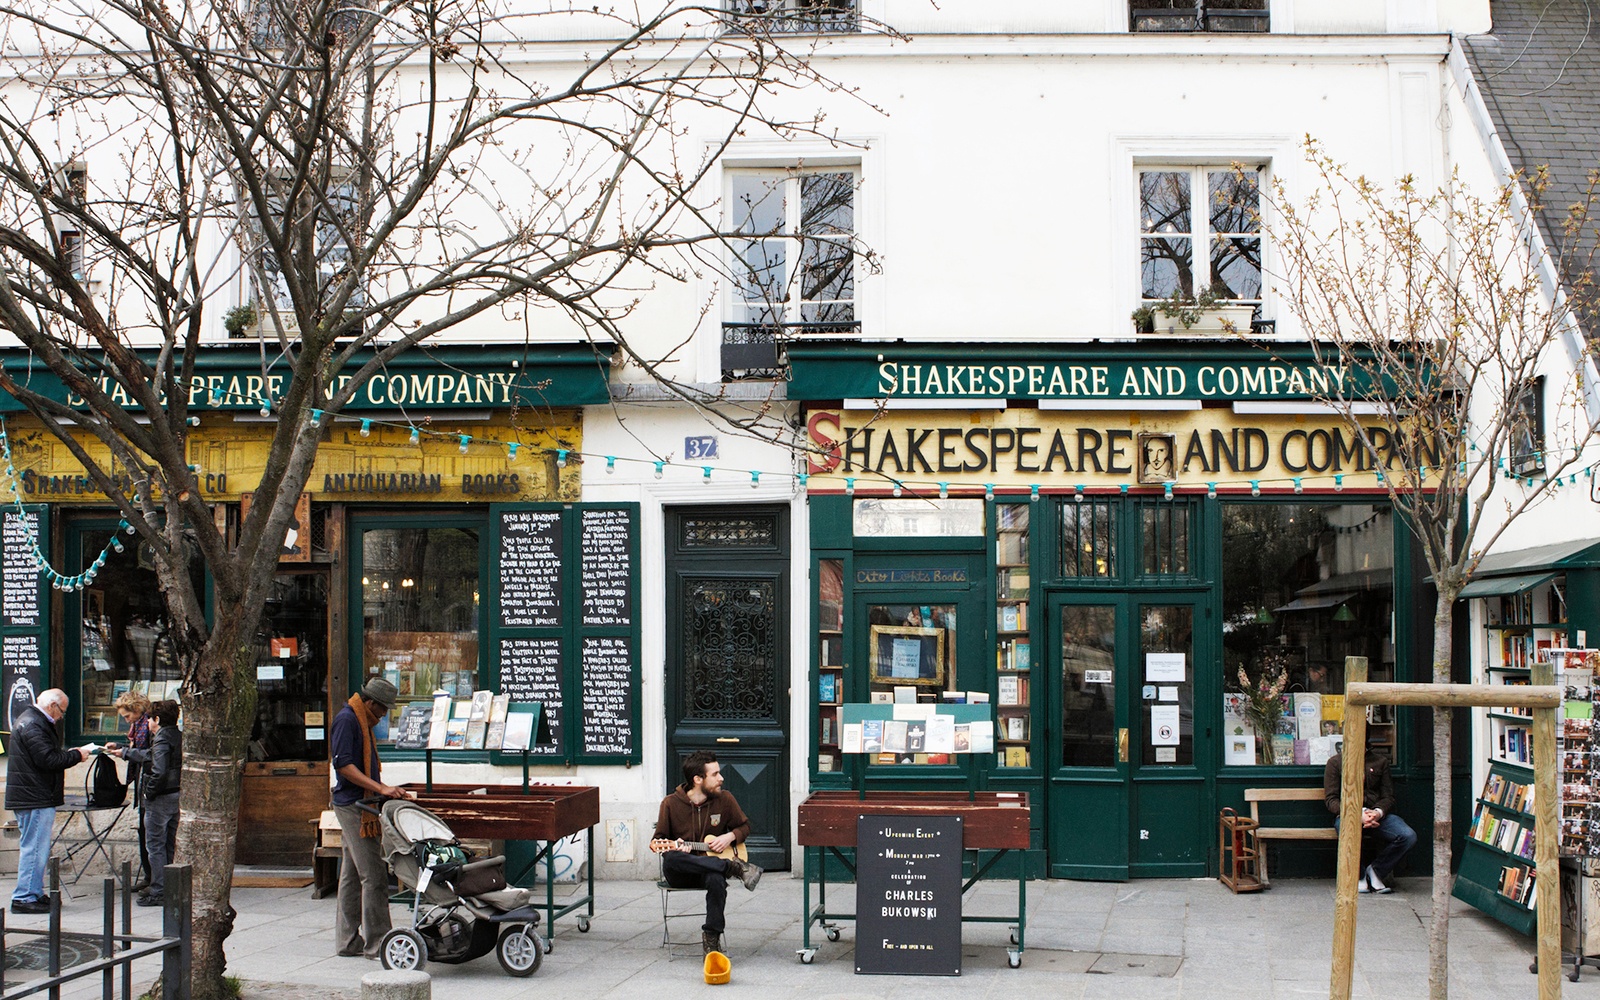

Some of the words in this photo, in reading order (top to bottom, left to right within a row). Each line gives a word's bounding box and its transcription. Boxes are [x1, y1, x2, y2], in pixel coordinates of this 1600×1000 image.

[367, 373, 516, 404] COMPANY
[878, 362, 1109, 396] SHAKESPEARE
[1119, 365, 1186, 396] AND
[1197, 365, 1349, 396] COMPANY
[689, 439, 714, 458] 37
[808, 412, 1133, 475] SHAKESPEARE
[1180, 427, 1270, 473] AND
[1281, 428, 1460, 473] COMPAN
[323, 472, 441, 494] ANTIQUARIAN
[461, 472, 520, 494] BOOKS
[933, 569, 967, 583] Books
[885, 890, 934, 901] CHARLES
[881, 907, 937, 918] BUKOWSKI
